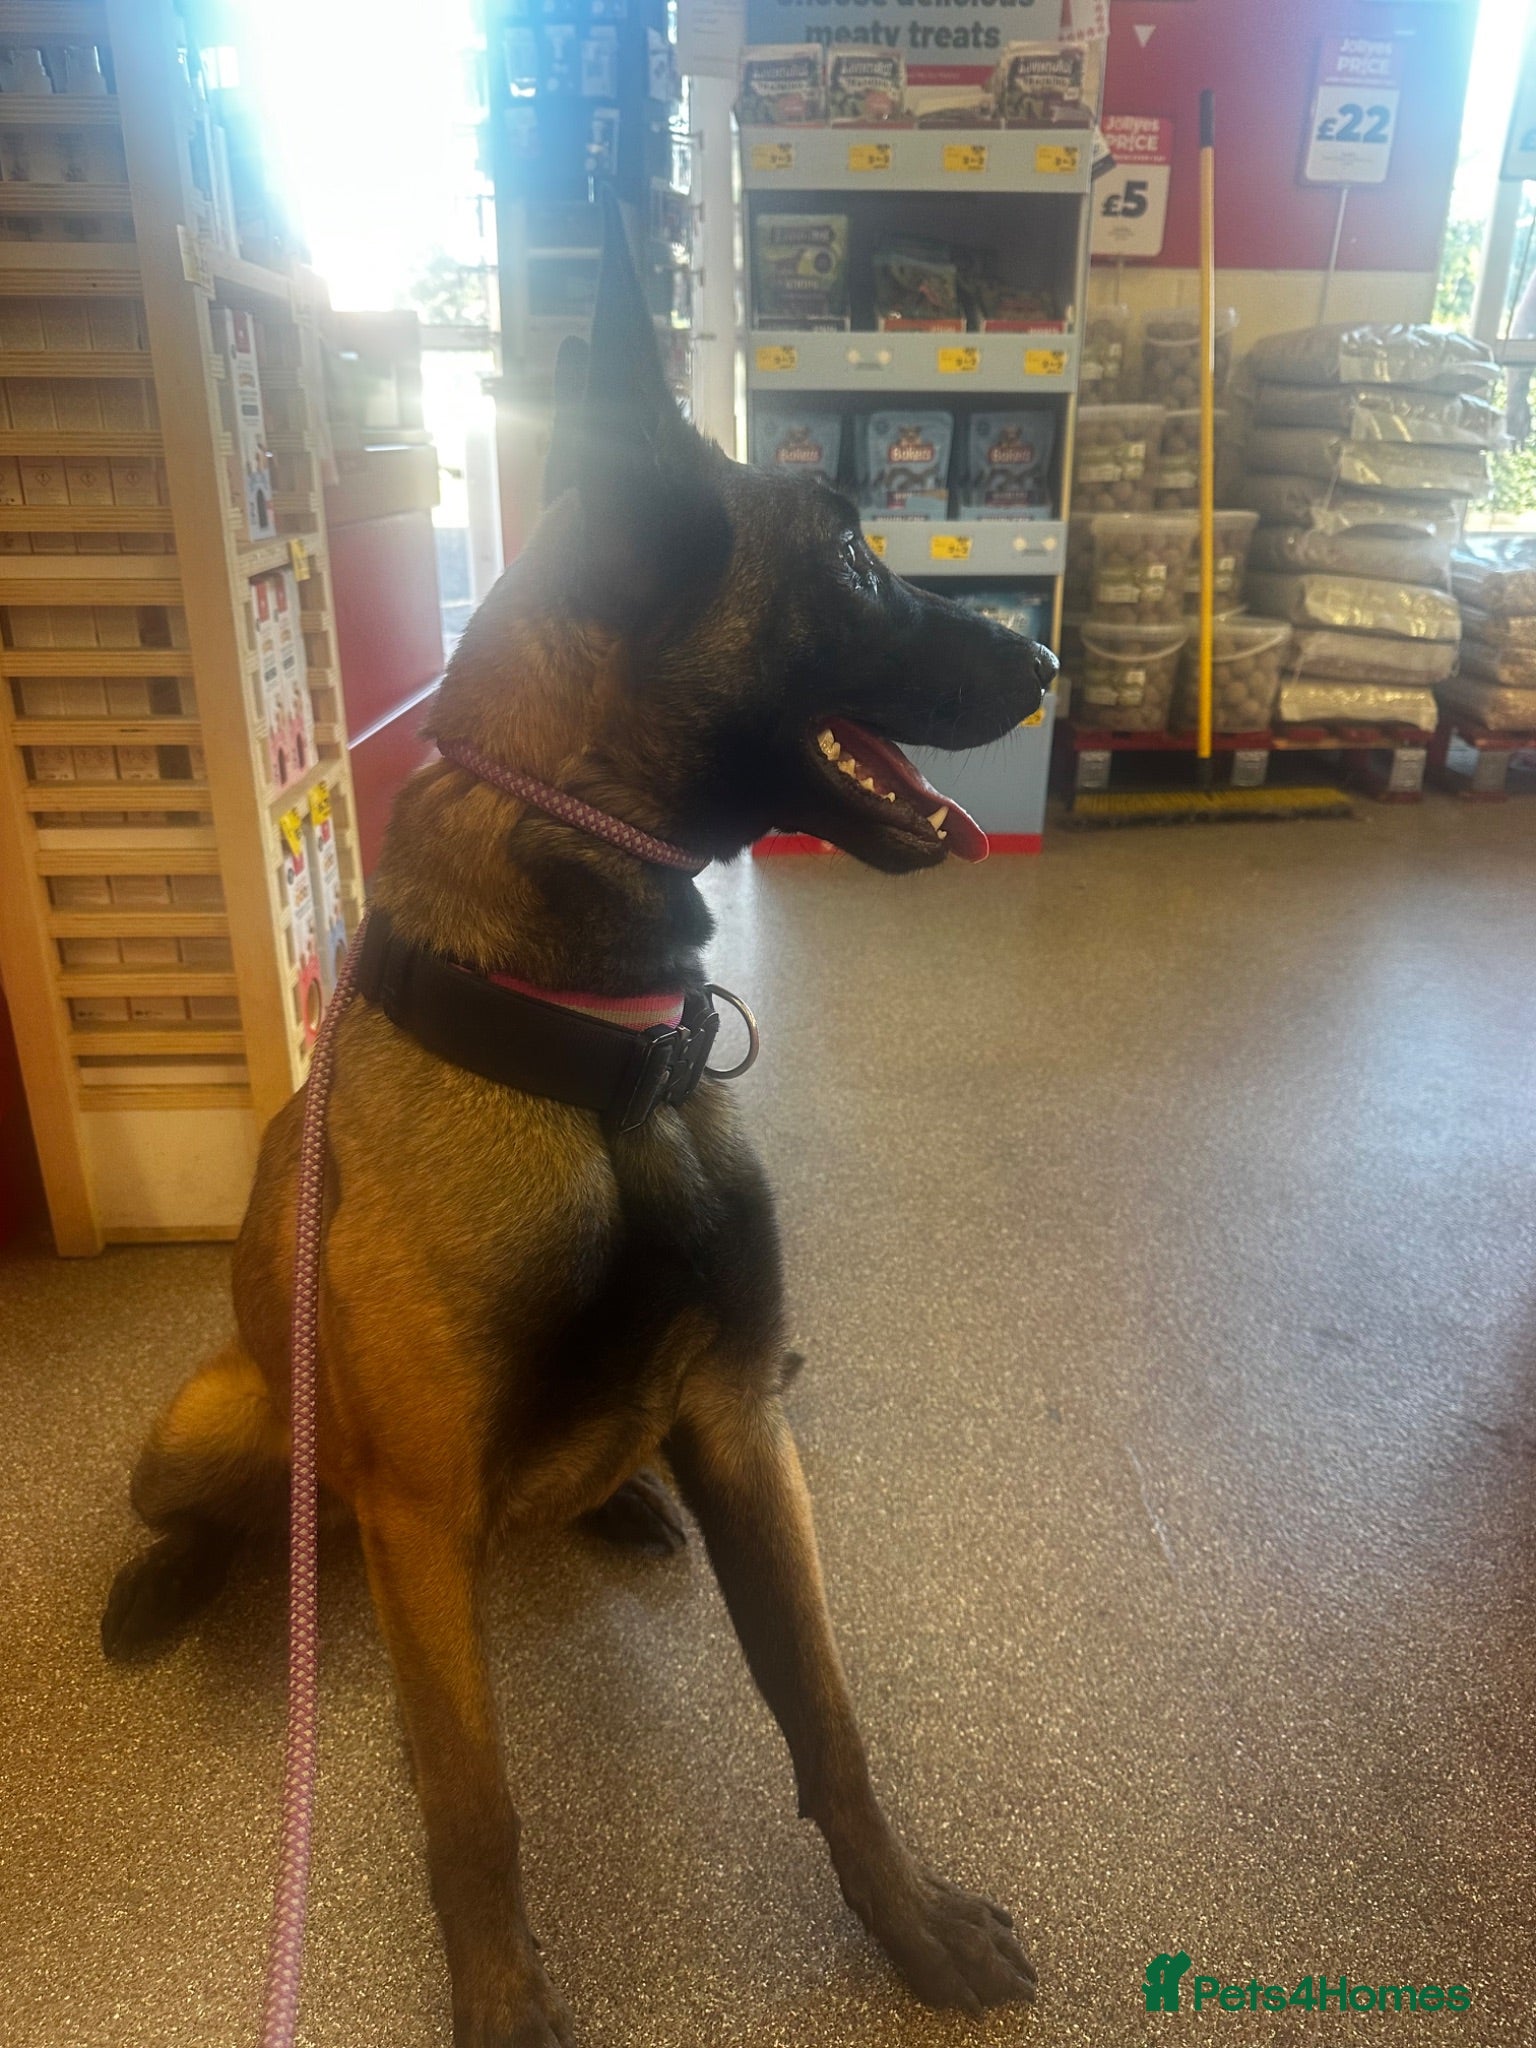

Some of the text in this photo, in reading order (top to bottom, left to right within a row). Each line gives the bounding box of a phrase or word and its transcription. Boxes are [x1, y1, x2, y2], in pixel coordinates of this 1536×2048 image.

[908, 20, 1001, 48] treats
[1316, 103, 1390, 143] £22
[1102, 181, 1148, 218] £5
